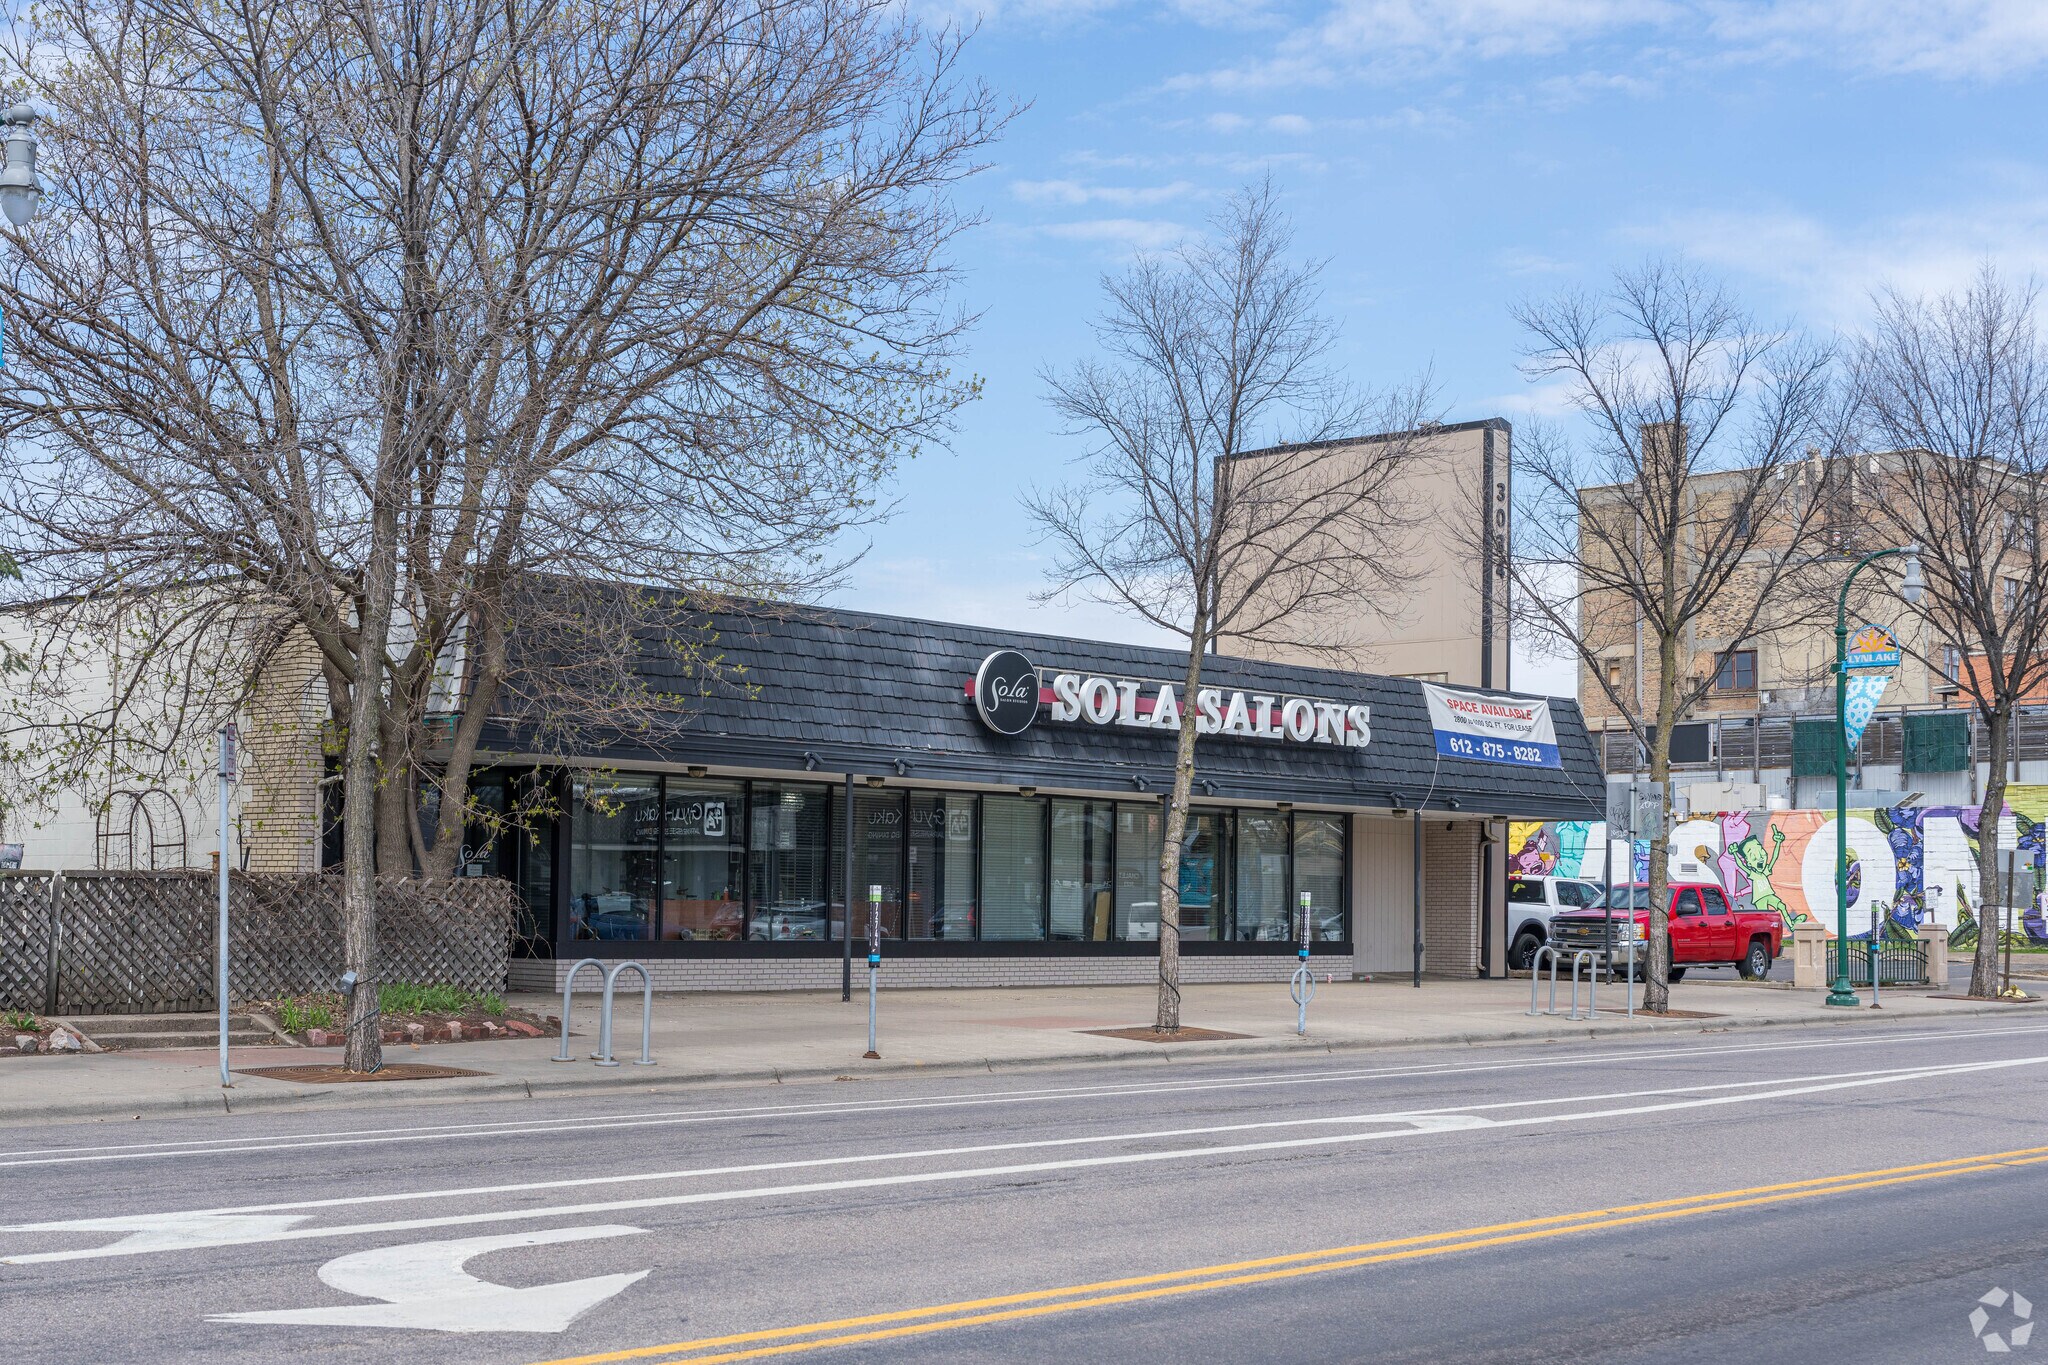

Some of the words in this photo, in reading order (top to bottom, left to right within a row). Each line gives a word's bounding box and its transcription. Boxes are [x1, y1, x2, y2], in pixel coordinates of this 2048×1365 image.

[1849, 653, 1898, 663] LYNLAKE
[986, 673, 1037, 712] Sola
[1051, 673, 1181, 731] SOLA
[1195, 688, 1371, 748] SALONS
[1447, 698, 1479, 713] SPACE
[1481, 704, 1533, 720] AVAILABLE
[1504, 722, 1514, 731] FOR
[1515, 724, 1532, 733] LEASE
